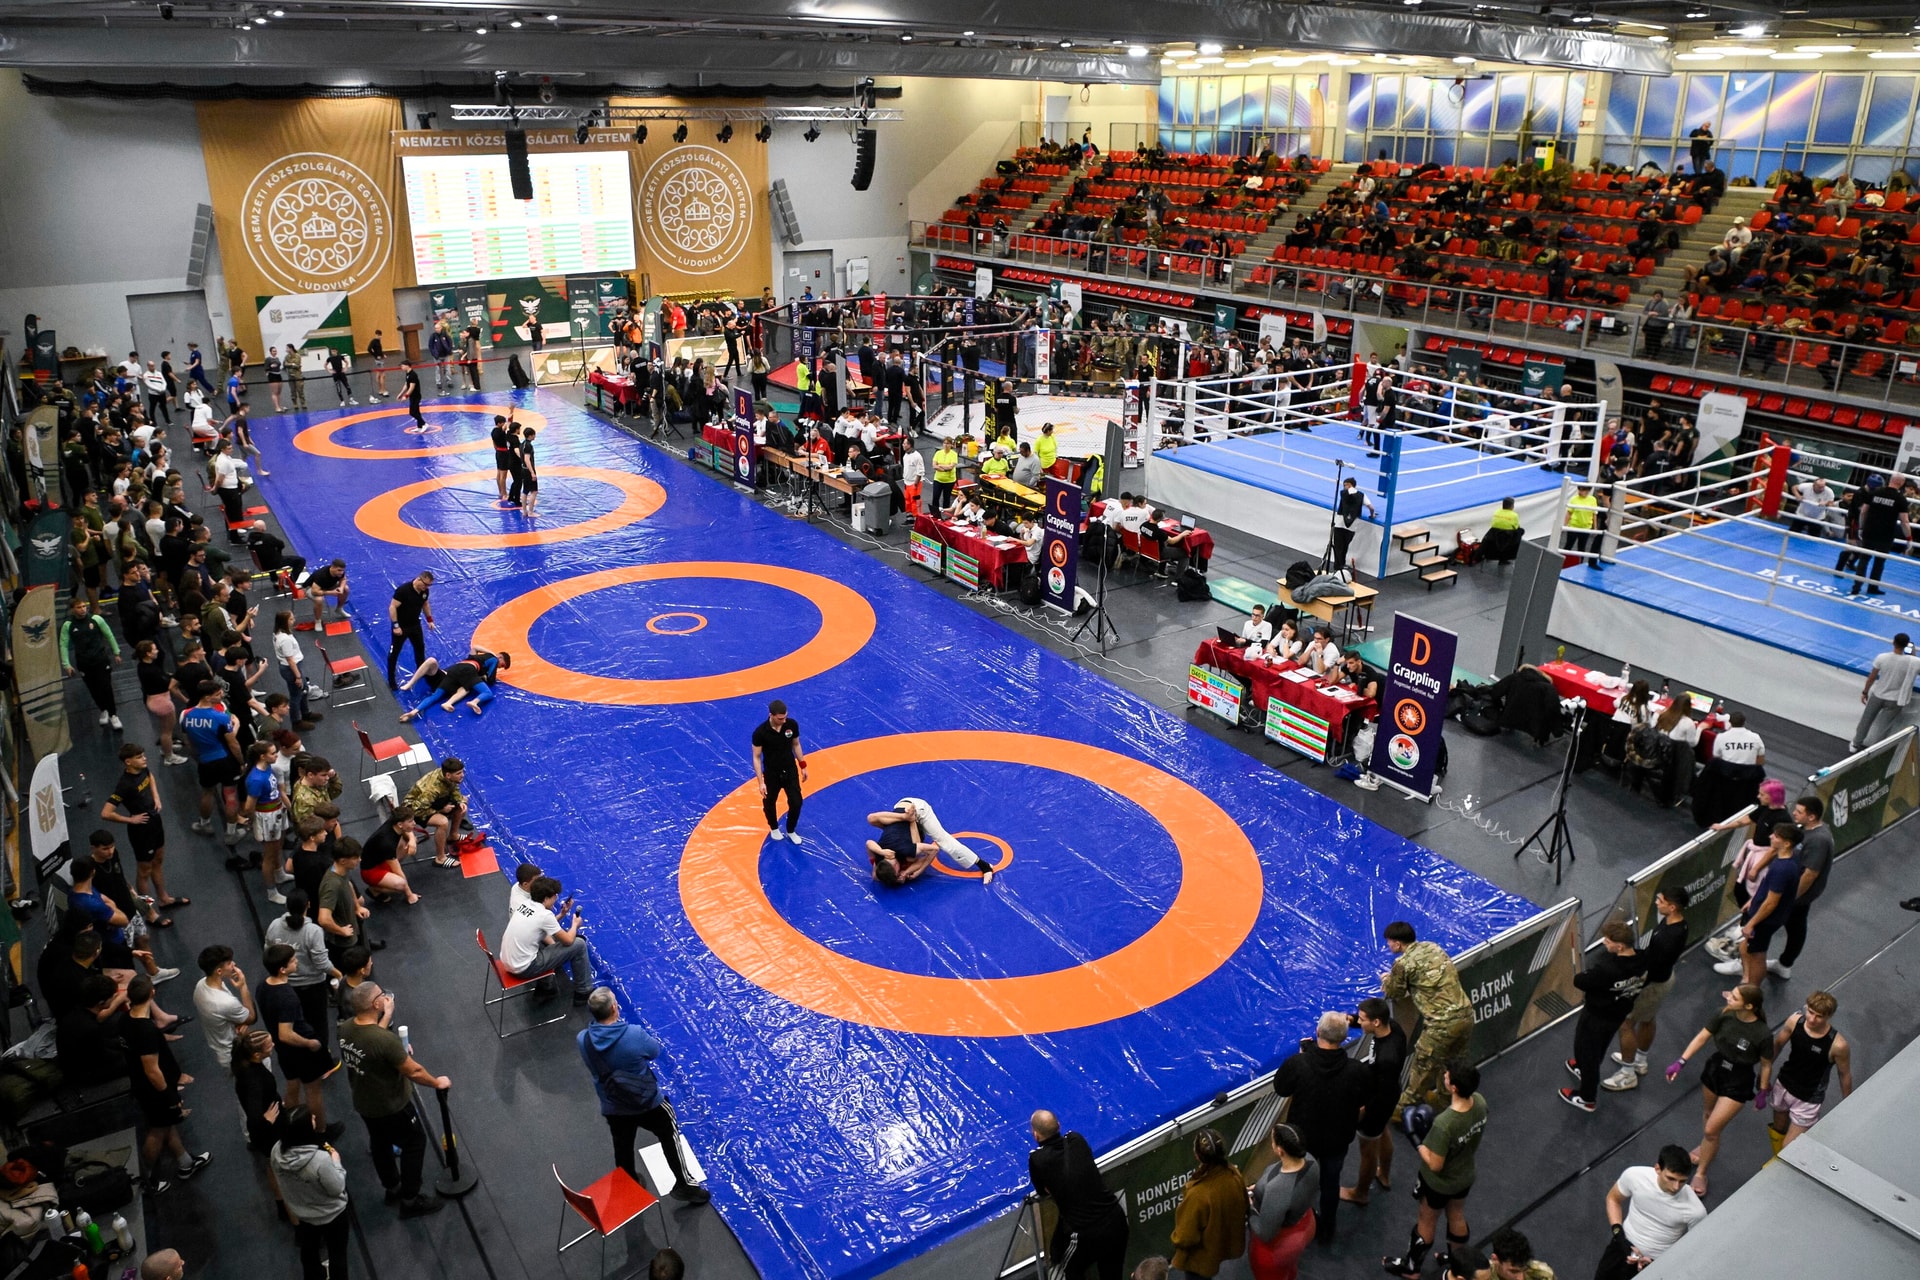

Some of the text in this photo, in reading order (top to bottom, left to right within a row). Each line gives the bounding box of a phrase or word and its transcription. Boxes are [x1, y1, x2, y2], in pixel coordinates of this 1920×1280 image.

[400, 132, 631, 147] NEMZETI KÖZSZGÁLATI YETEM
[646, 153, 746, 223] NEMZETI KÖZSZOLGÁLATI EGYETEM
[252, 189, 267, 242] NEMZETI
[265, 162, 356, 188] KÖZSZOLGÁLATI
[357, 183, 383, 235] EGYETEM
[678, 254, 723, 267] LUDOVIKA
[298, 275, 356, 291] LUDOVIKA
[740, 396, 746, 415] B
[1056, 490, 1068, 516] C
[1046, 513, 1075, 534] Grappling
[1410, 631, 1431, 666] D
[1393, 662, 1441, 694] Grappling
[185, 718, 212, 729] HUN
[1724, 742, 1755, 750] STAFF
[517, 904, 535, 918] STAFF
[1471, 970, 1515, 1005] BÁTRAK
[1473, 993, 1512, 1024] LIGÁJA
[1137, 1169, 1196, 1206] HONVÉDE
